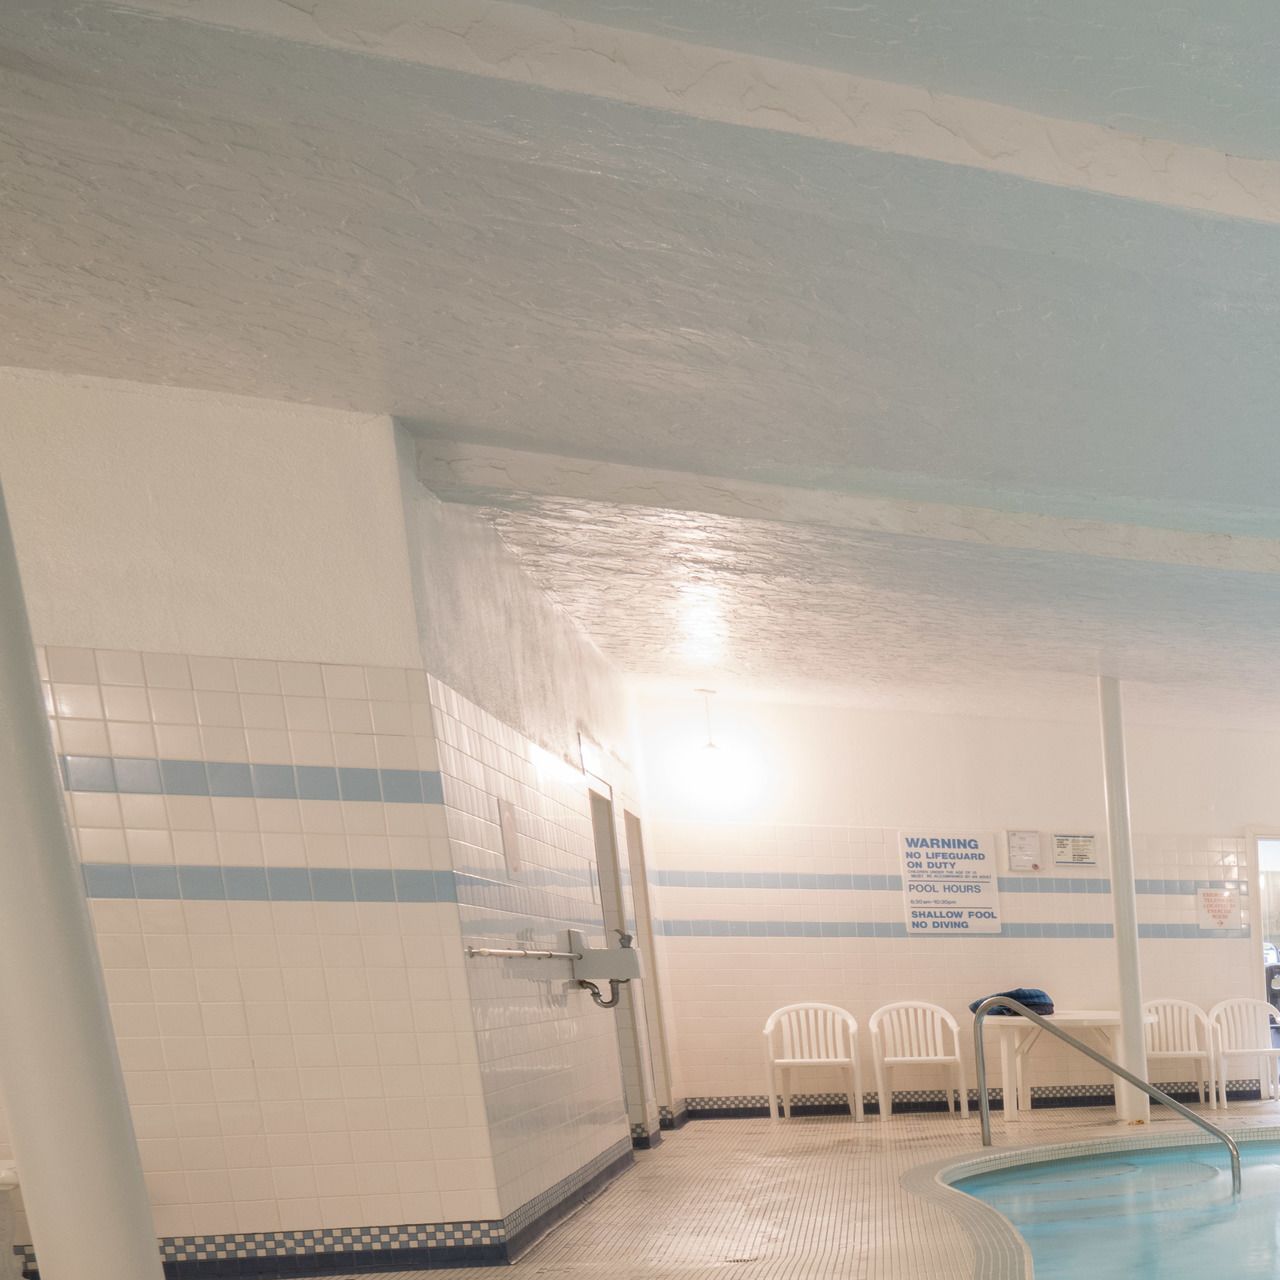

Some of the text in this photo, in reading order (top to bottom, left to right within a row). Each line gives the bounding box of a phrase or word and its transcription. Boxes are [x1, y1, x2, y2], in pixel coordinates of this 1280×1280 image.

[905, 837, 979, 849] WARNING
[906, 851, 986, 860] NO LIFEGUARD
[907, 861, 923, 869] ON
[908, 884, 982, 893] POOL HOURS
[911, 910, 964, 919] SHALLOW
[932, 921, 969, 929] DIVING
